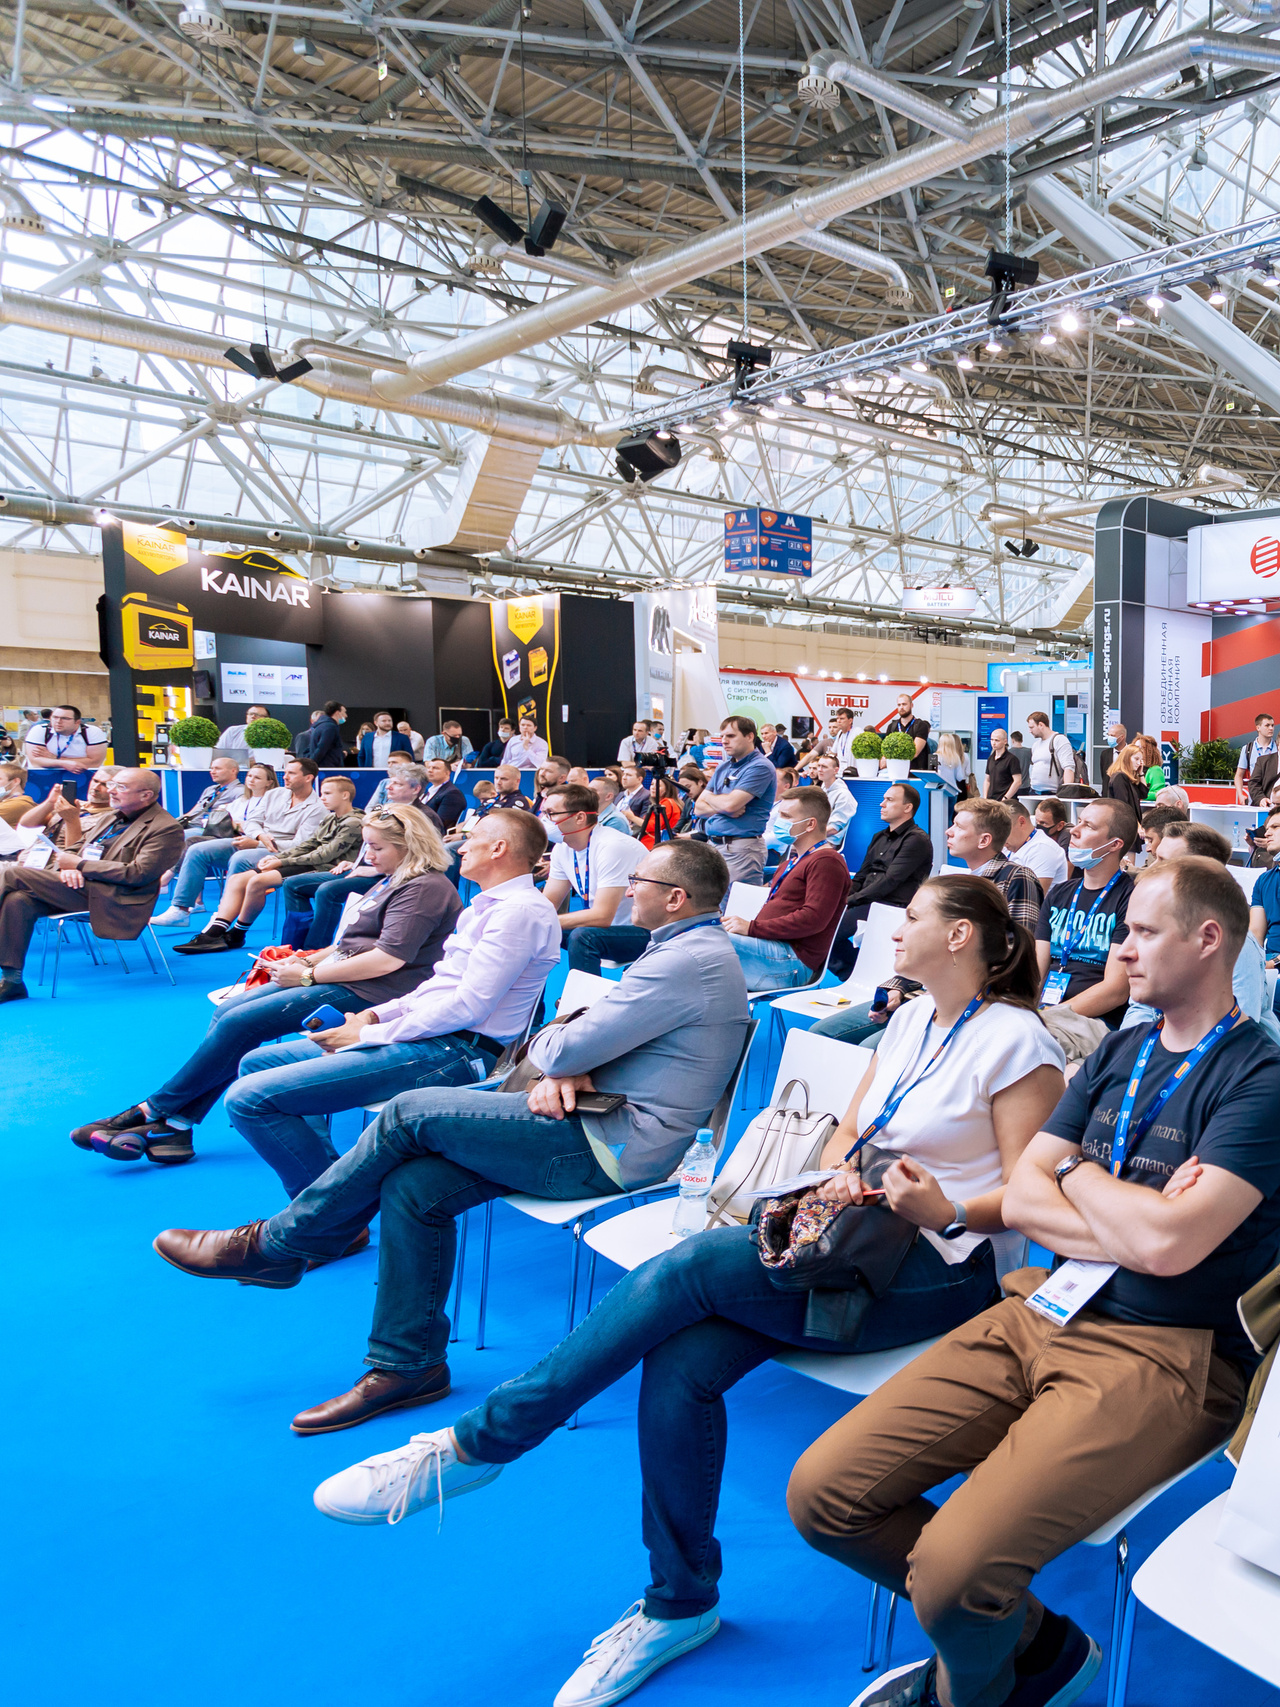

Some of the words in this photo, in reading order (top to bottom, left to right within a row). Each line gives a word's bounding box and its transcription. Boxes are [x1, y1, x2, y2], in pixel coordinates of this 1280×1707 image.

[136, 538, 176, 552] KAINAR
[201, 567, 311, 609] KAINAR
[923, 592, 954, 601] MUTLU
[514, 611, 536, 620] KAINAR
[148, 630, 180, 642] KAINAR
[1102, 608, 1113, 740] www.npc-springs.ru
[1160, 622, 1168, 724] ОБЪЕДИНЕННАЯ
[731, 679, 778, 688] автомобилей
[726, 694, 769, 702] Старт-Стоп
[826, 693, 869, 708] MUTLU
